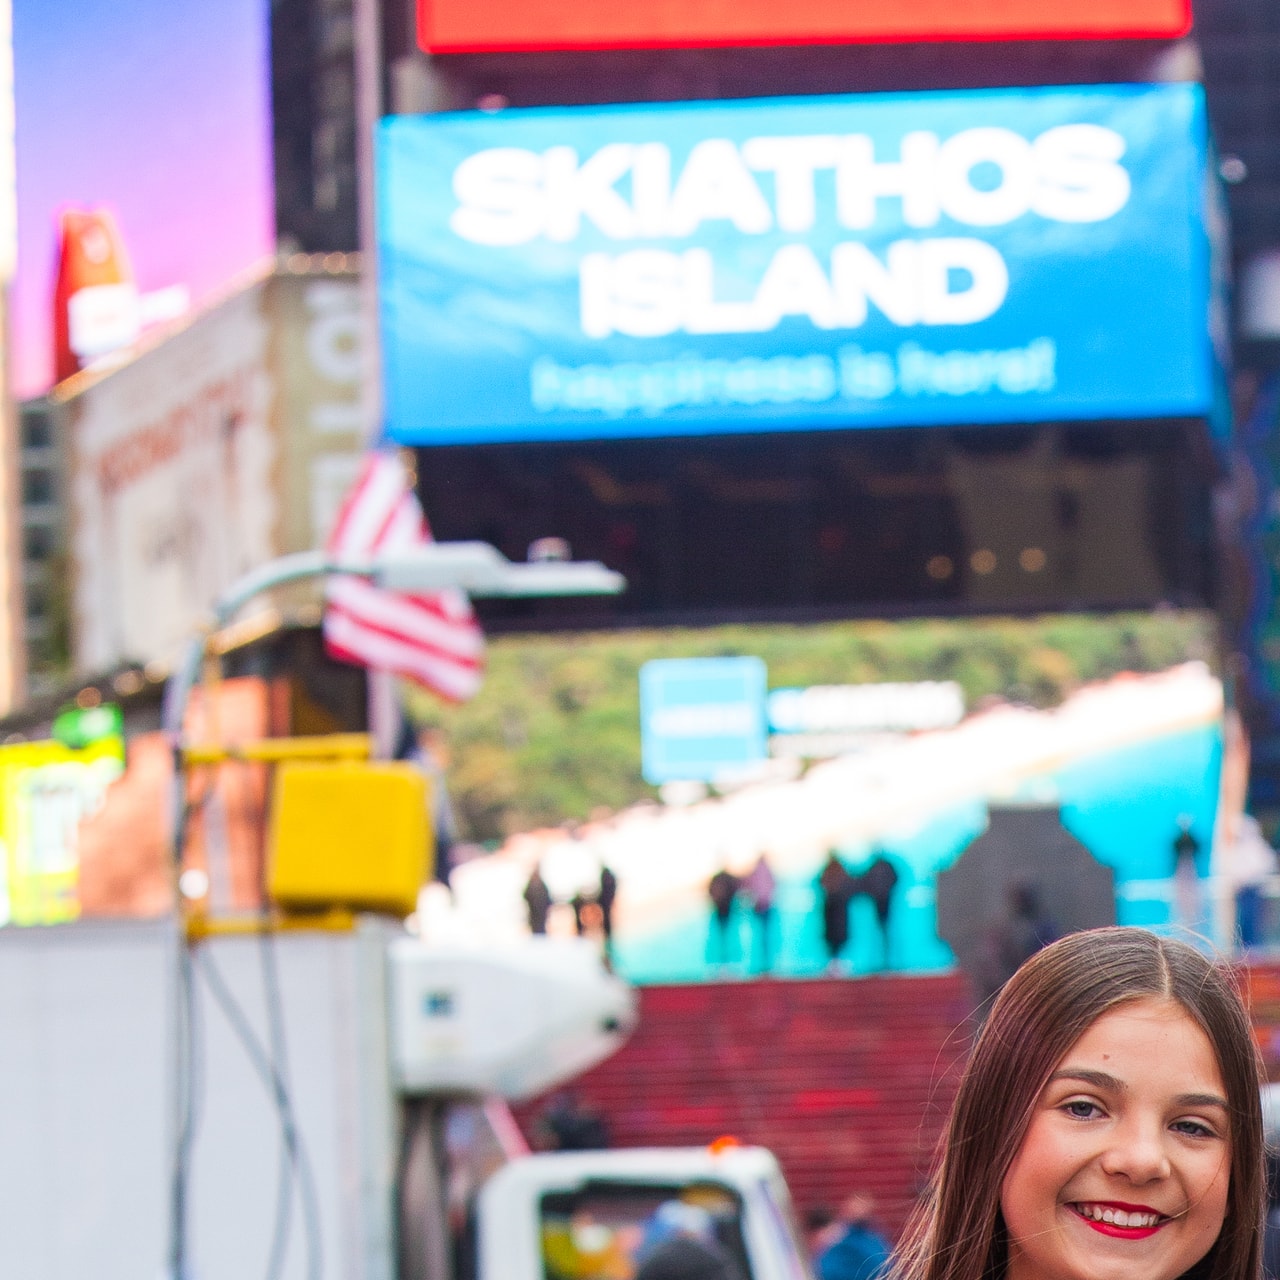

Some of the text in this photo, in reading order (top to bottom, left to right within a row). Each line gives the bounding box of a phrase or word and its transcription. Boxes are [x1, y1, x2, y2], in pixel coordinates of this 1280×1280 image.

[452, 124, 1131, 245] SKIATHOS
[579, 239, 1008, 337] ISLAND
[530, 338, 1056, 418] happiness is here!
